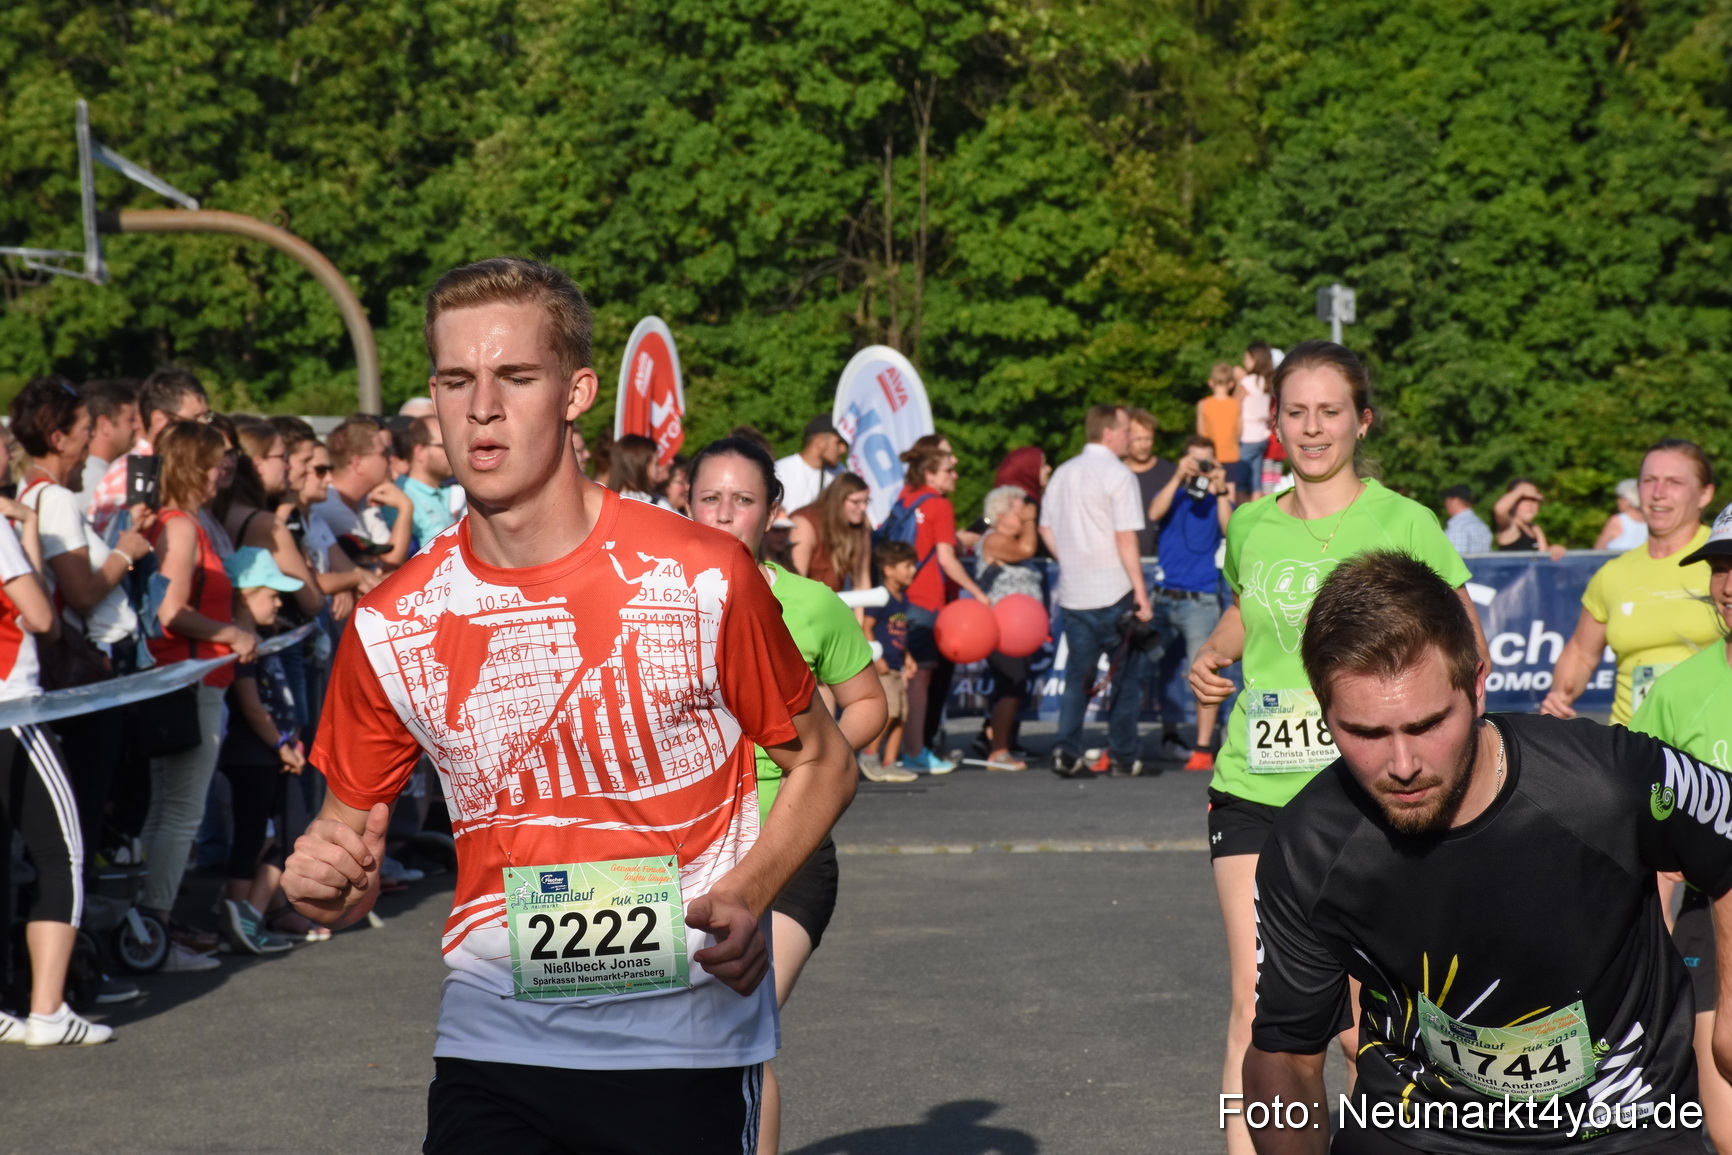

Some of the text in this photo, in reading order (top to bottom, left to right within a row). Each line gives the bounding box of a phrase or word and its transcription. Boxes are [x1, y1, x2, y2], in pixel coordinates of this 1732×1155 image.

[476, 592, 522, 612] 10.54
[638, 587, 696, 604] 91.62%
[490, 672, 536, 694] 52.01
[497, 698, 543, 721] 26.22
[1256, 718, 1334, 748] 2418
[1258, 758, 1297, 766] Zahnarztpraxis
[1261, 748, 1335, 758] Dr. Christa Teresa
[531, 887, 595, 904] firmenlauf
[611, 891, 669, 906] run 2019
[528, 906, 660, 960] 2222
[543, 956, 651, 975] Nießlbeck Jonas
[533, 968, 665, 986] Sparkasse Neumarkt-Parsberg
[1547, 1029, 1577, 1047] 2019
[1440, 1039, 1571, 1081] 1744
[1457, 1066, 1498, 1087] Keindl
[1501, 1077, 1559, 1090] Andreas
